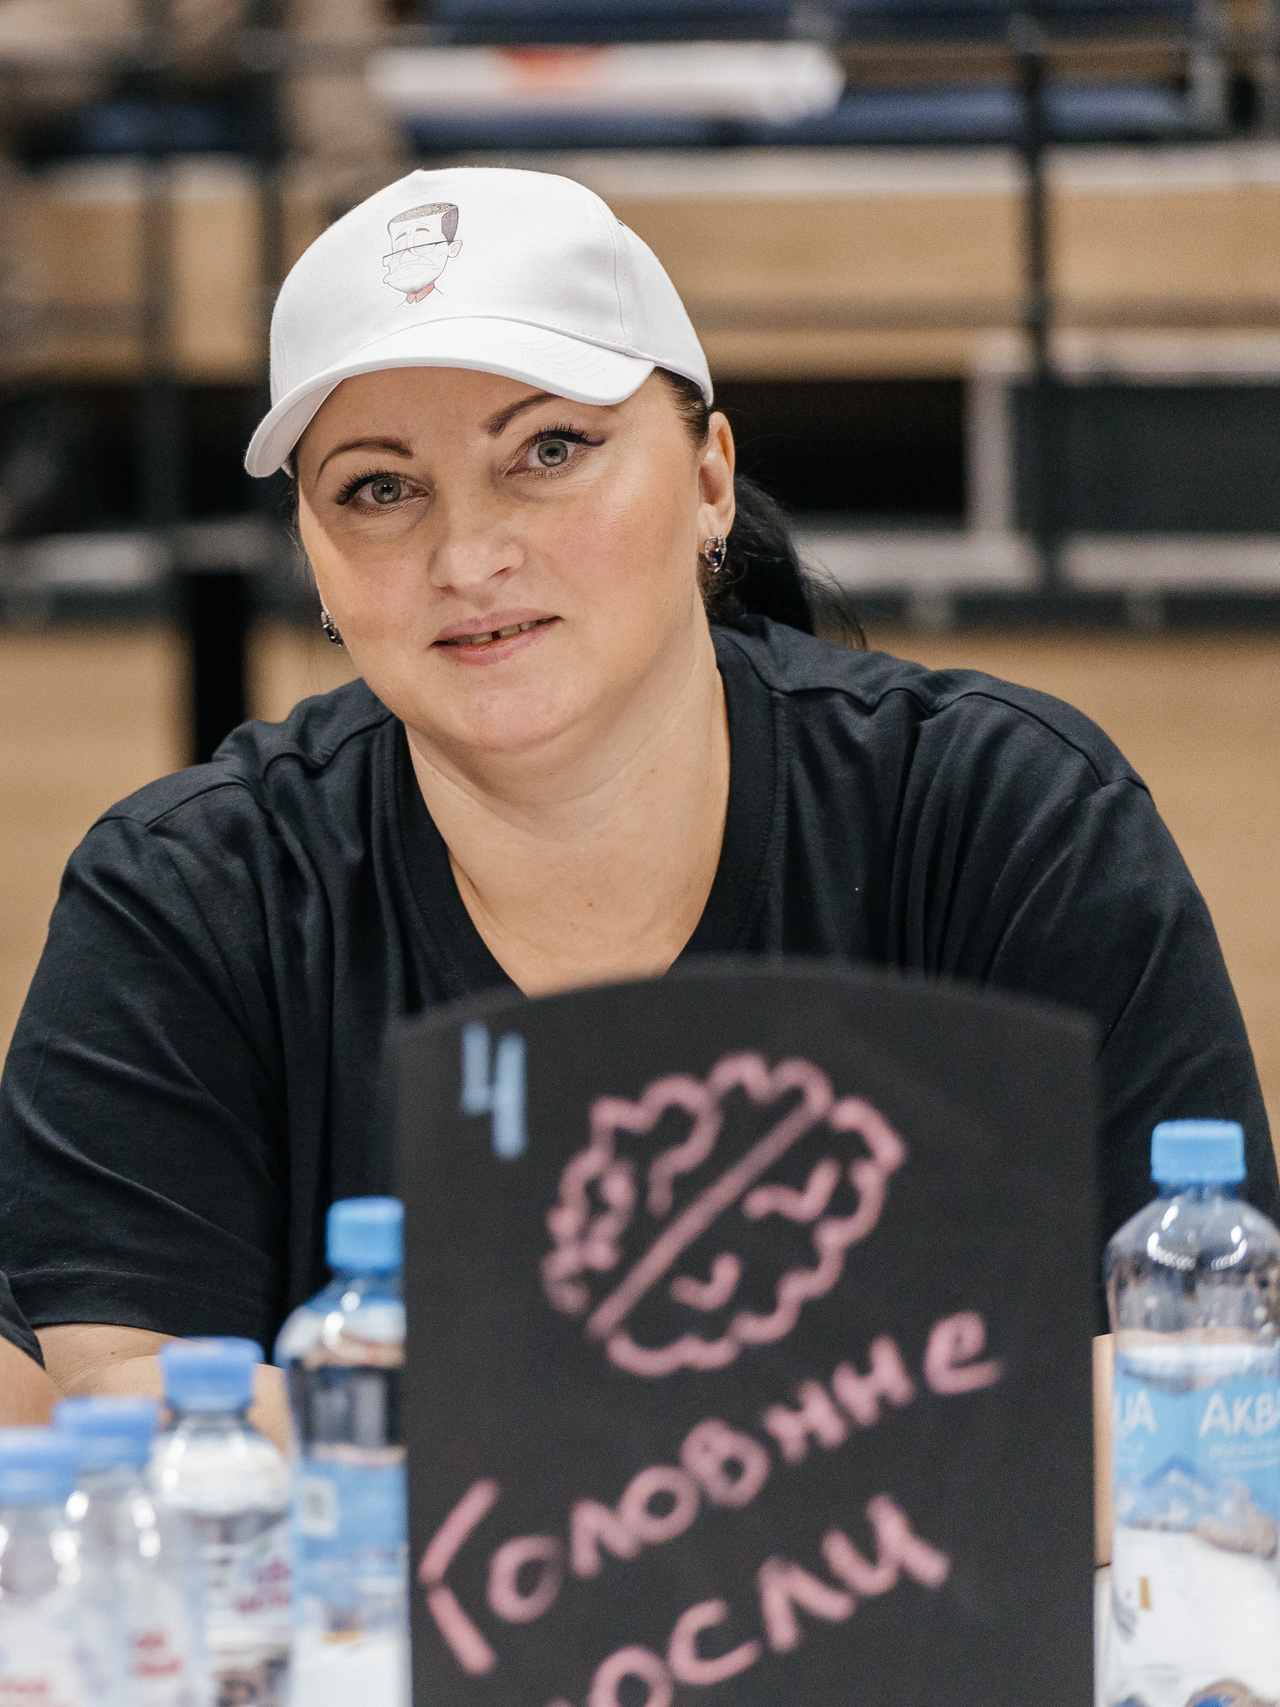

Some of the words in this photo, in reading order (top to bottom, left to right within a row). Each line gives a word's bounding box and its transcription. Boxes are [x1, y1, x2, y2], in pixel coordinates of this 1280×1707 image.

[461, 1022, 527, 1160] 4
[1198, 1391, 1280, 1437] АКВ
[548, 1495, 951, 1707] осли
